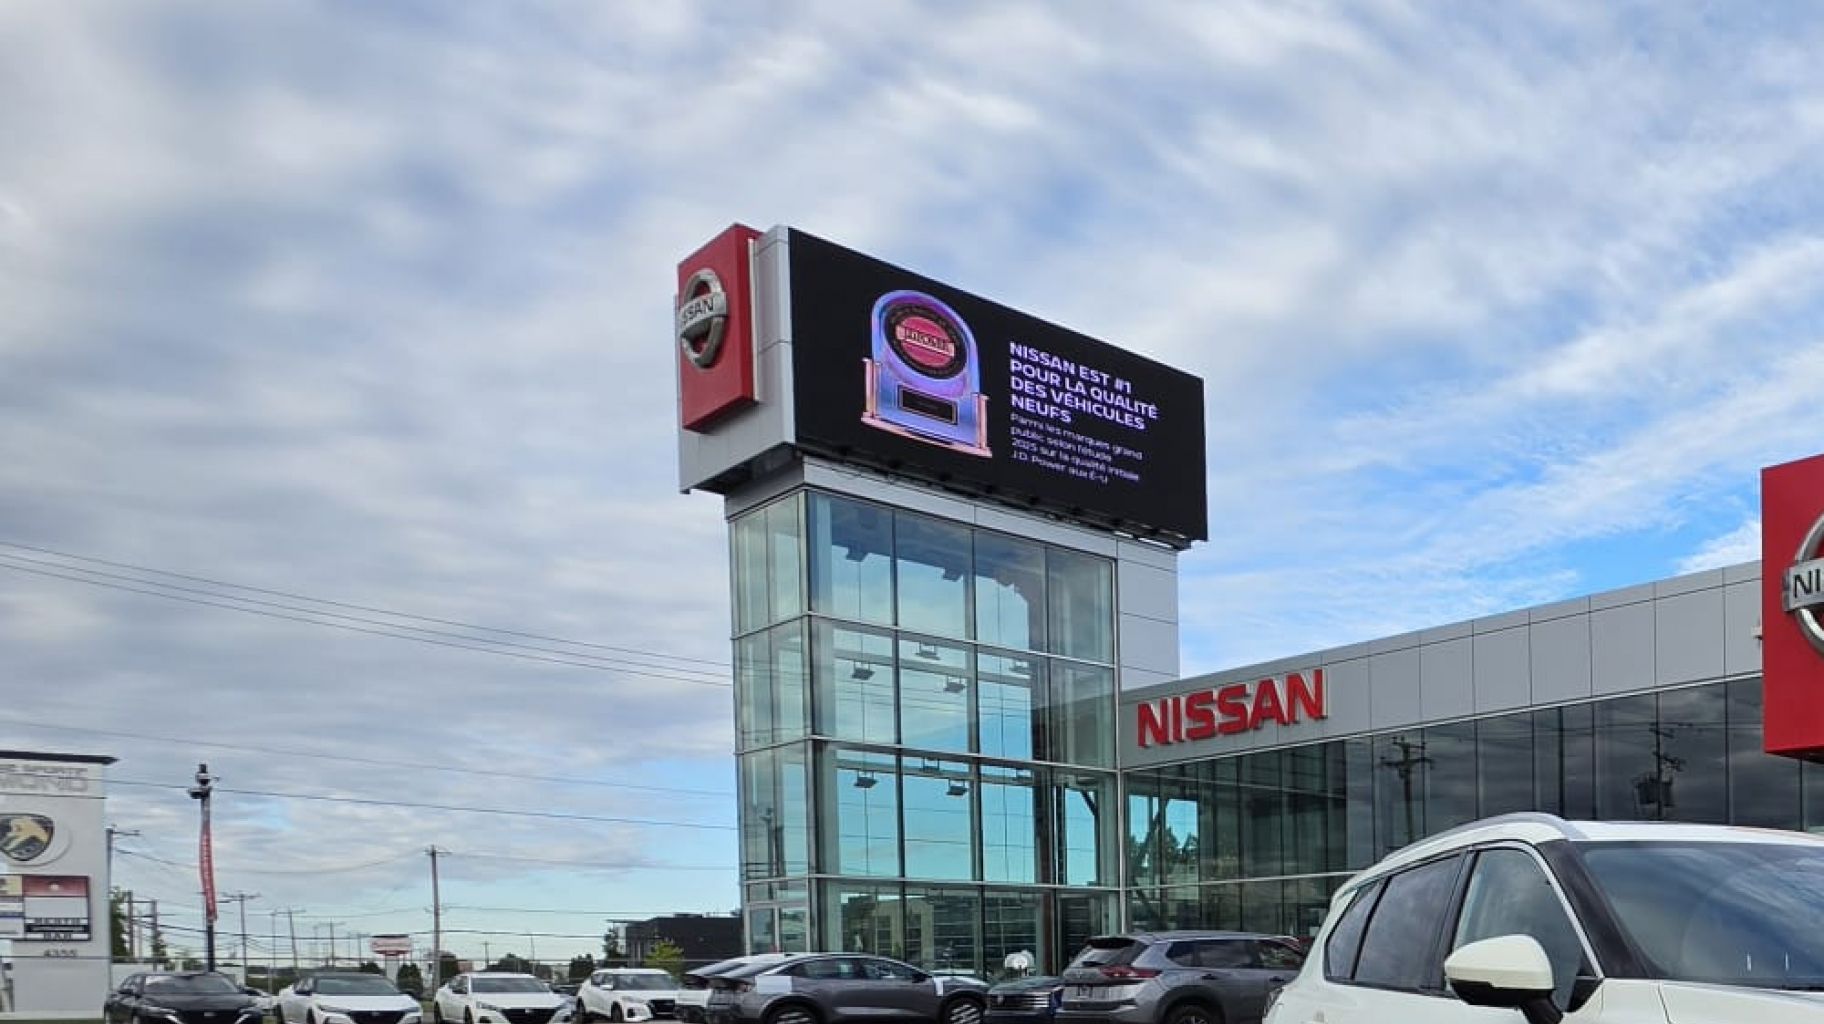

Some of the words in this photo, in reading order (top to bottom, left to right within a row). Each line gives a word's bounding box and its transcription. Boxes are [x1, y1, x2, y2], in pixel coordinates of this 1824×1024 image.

[1010, 341, 1076, 375] NISSAN
[1079, 365, 1111, 386] EST
[1010, 359, 1061, 387] POUR
[1065, 377, 1087, 396] LA
[1090, 386, 1159, 419] QUALITÉ
[1011, 376, 1048, 398] DES
[1050, 388, 1145, 430] VÉHICULES
[1011, 394, 1072, 423] NEUFS
[1137, 668, 1326, 748] NISSAN
